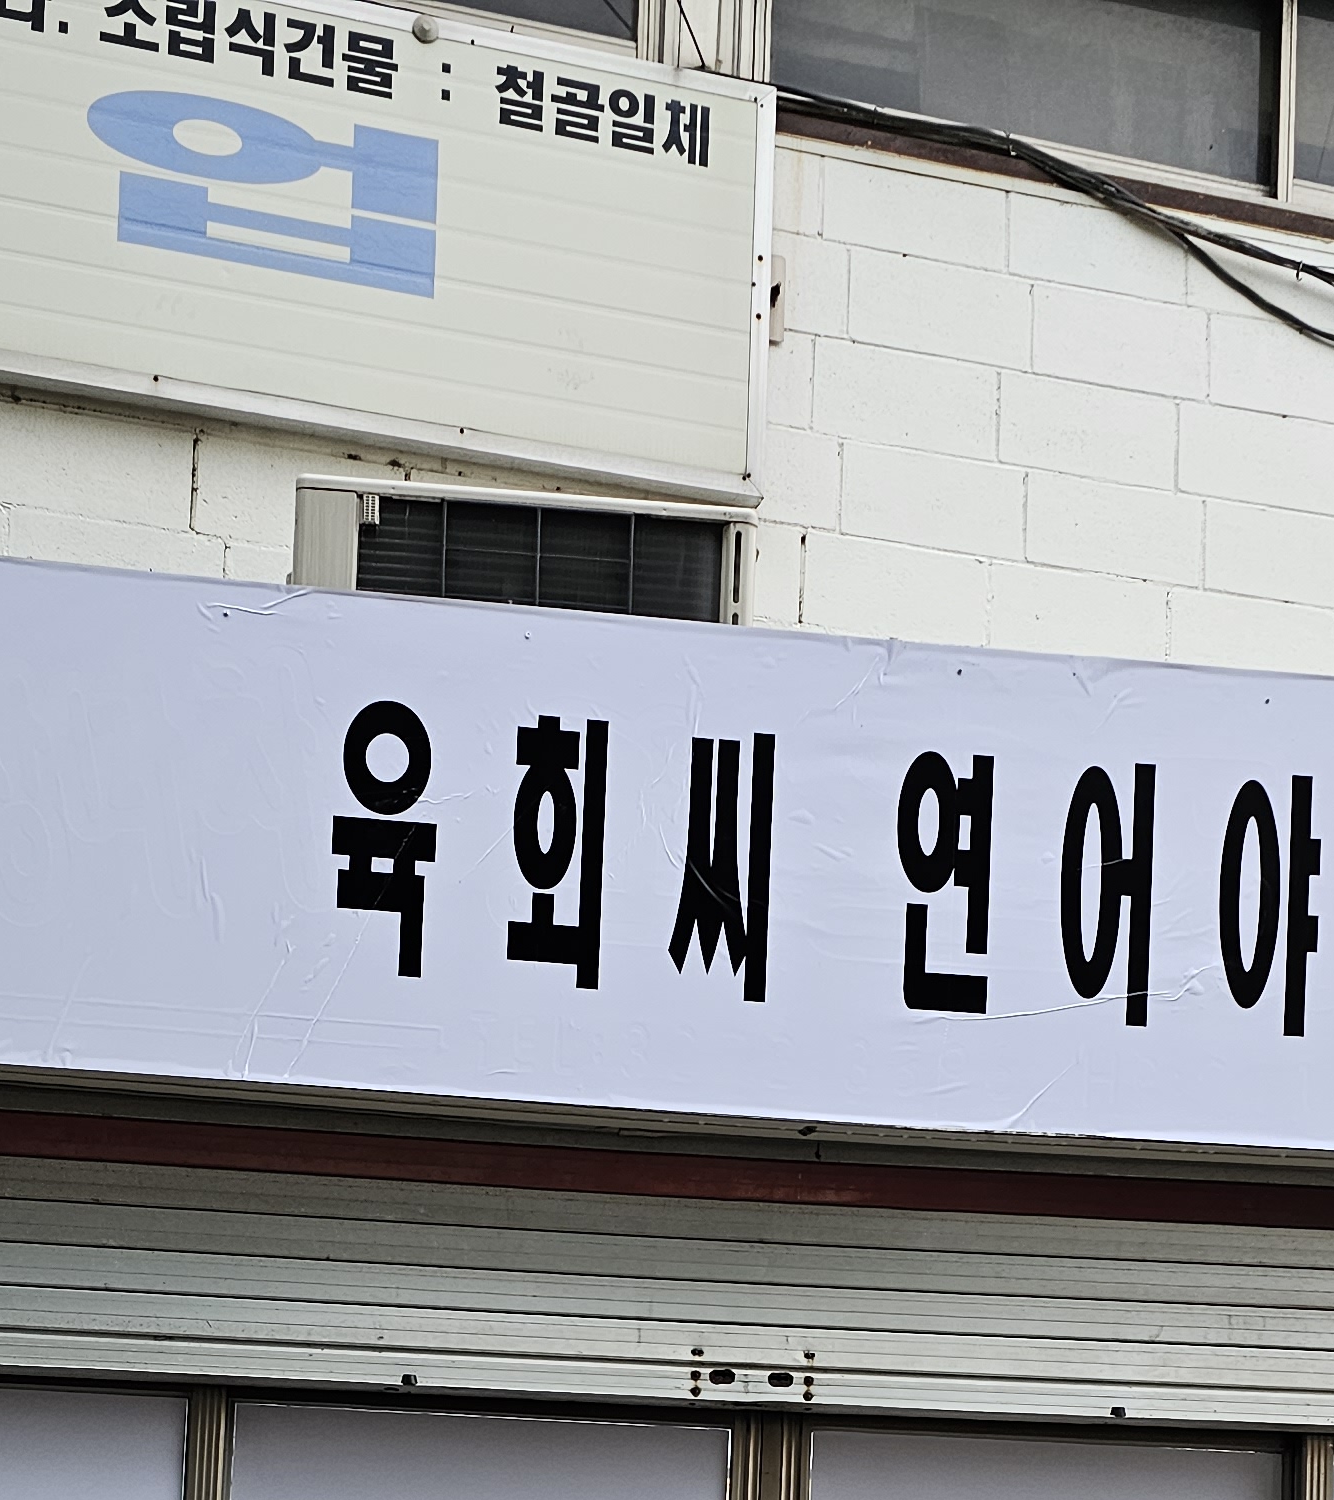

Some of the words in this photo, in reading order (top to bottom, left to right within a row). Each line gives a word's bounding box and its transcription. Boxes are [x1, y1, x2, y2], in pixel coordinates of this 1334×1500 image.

[495, 64, 710, 168] 철골일체
[332, 700, 776, 1003] 육회씨
[897, 750, 1322, 1038] 연어야
